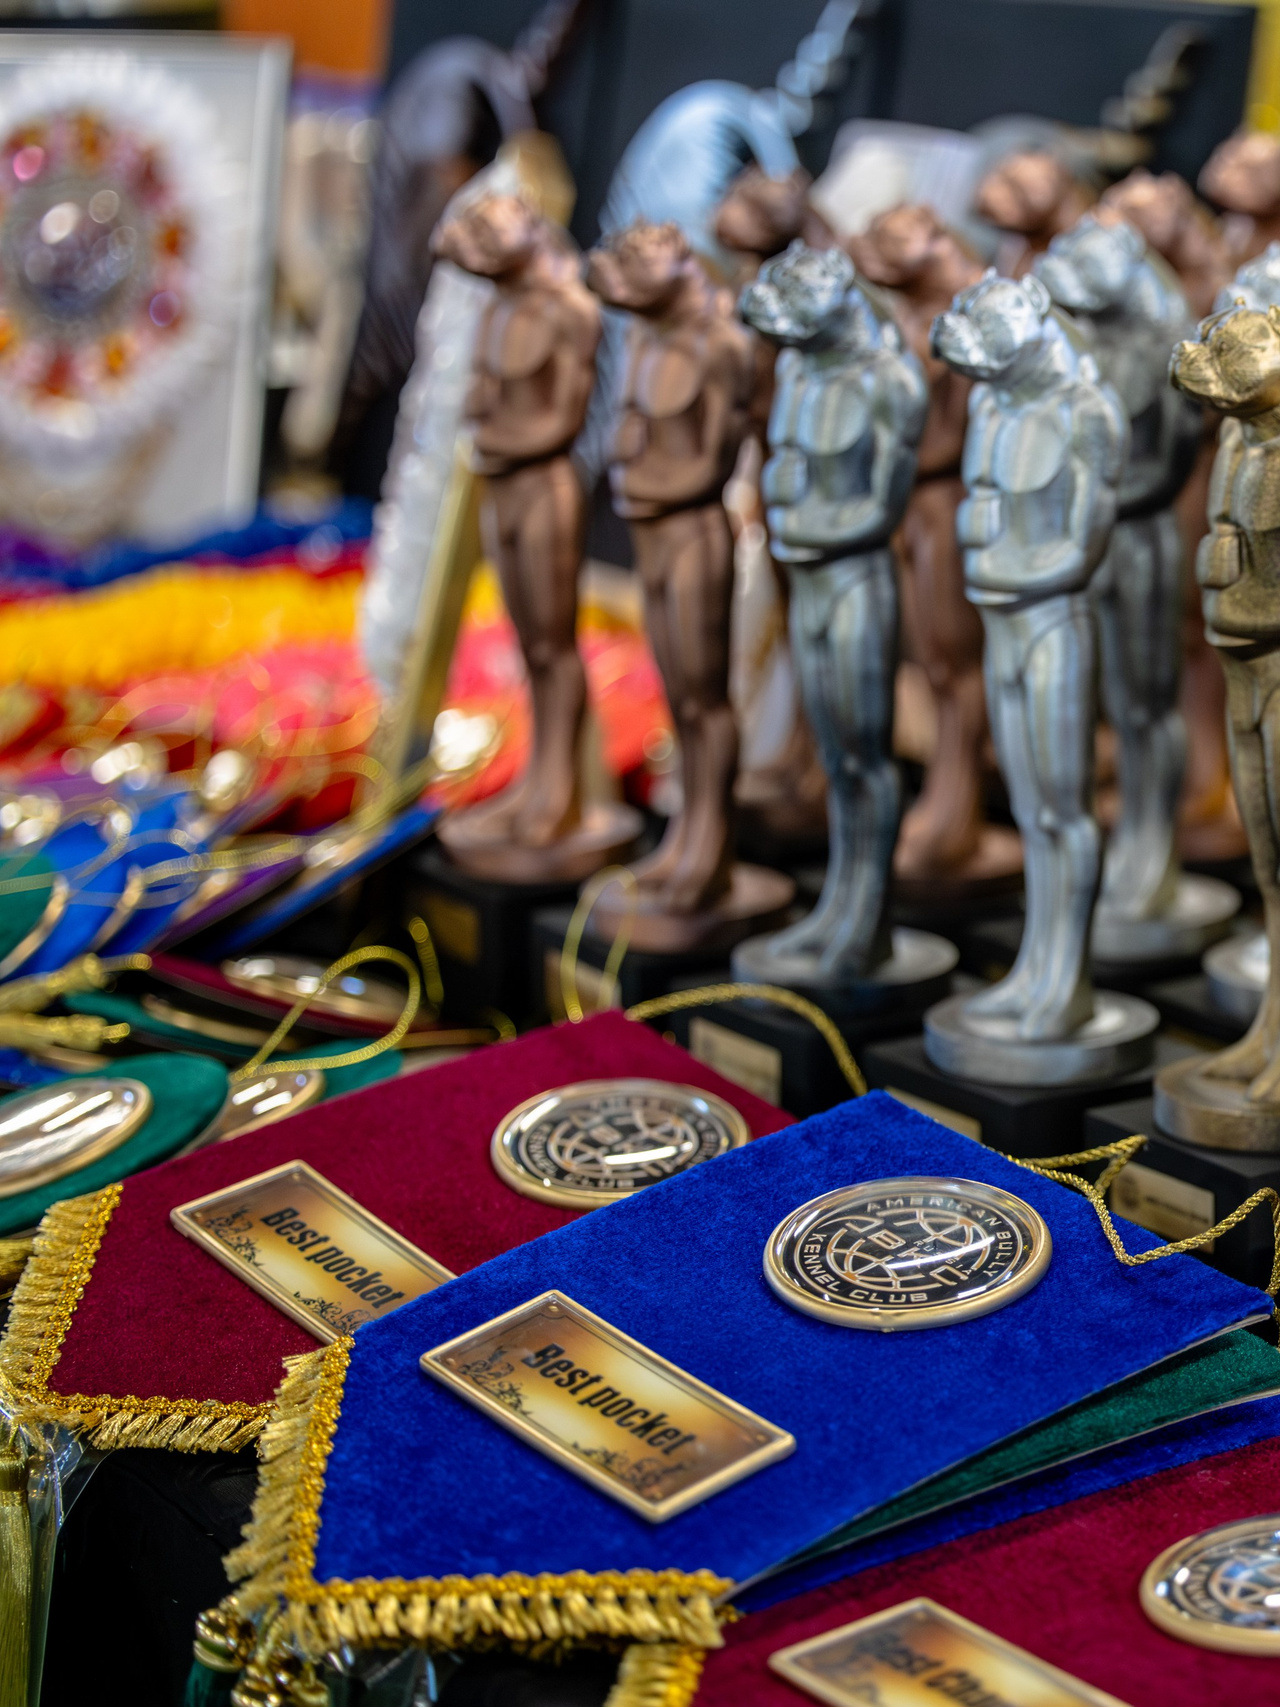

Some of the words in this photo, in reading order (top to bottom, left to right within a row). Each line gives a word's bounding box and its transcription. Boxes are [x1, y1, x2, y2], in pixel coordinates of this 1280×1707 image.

[259, 1206, 330, 1252] Best
[303, 1244, 406, 1308] pocket
[803, 1232, 840, 1293] KENNEL
[849, 1290, 929, 1303] CLUB
[867, 1195, 1002, 1226] AMERICAN
[983, 1231, 1013, 1278] BULLY
[520, 1343, 603, 1396] Best
[578, 1385, 697, 1457] pocket
